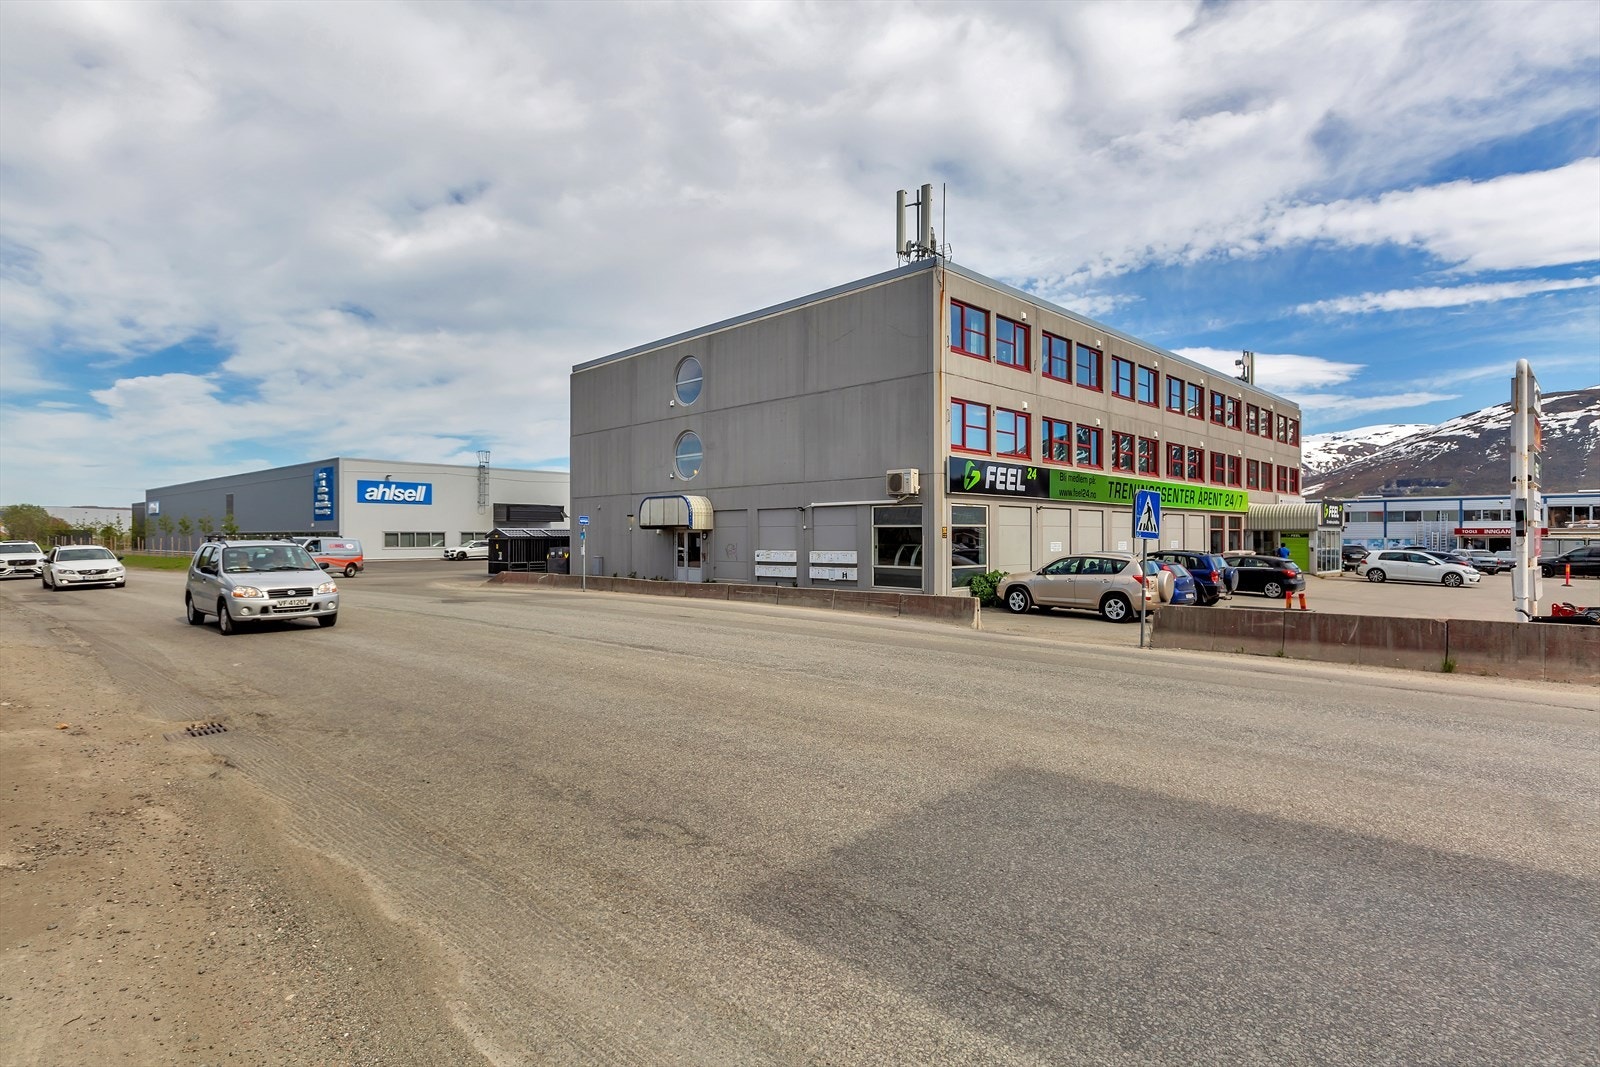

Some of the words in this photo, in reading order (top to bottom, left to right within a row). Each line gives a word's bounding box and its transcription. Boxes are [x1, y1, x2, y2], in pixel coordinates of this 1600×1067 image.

[986, 466, 1025, 491] FEEL
[1027, 468, 1037, 480] 24
[1059, 472, 1067, 482] Bli
[1068, 474, 1088, 483] medlem
[365, 484, 426, 501] ahlsell
[1059, 488, 1096, 498] www.feel24.no
[1198, 487, 1222, 506] ÅPENT
[1225, 494, 1242, 510] 24/7
[1328, 506, 1339, 518] FEEL
